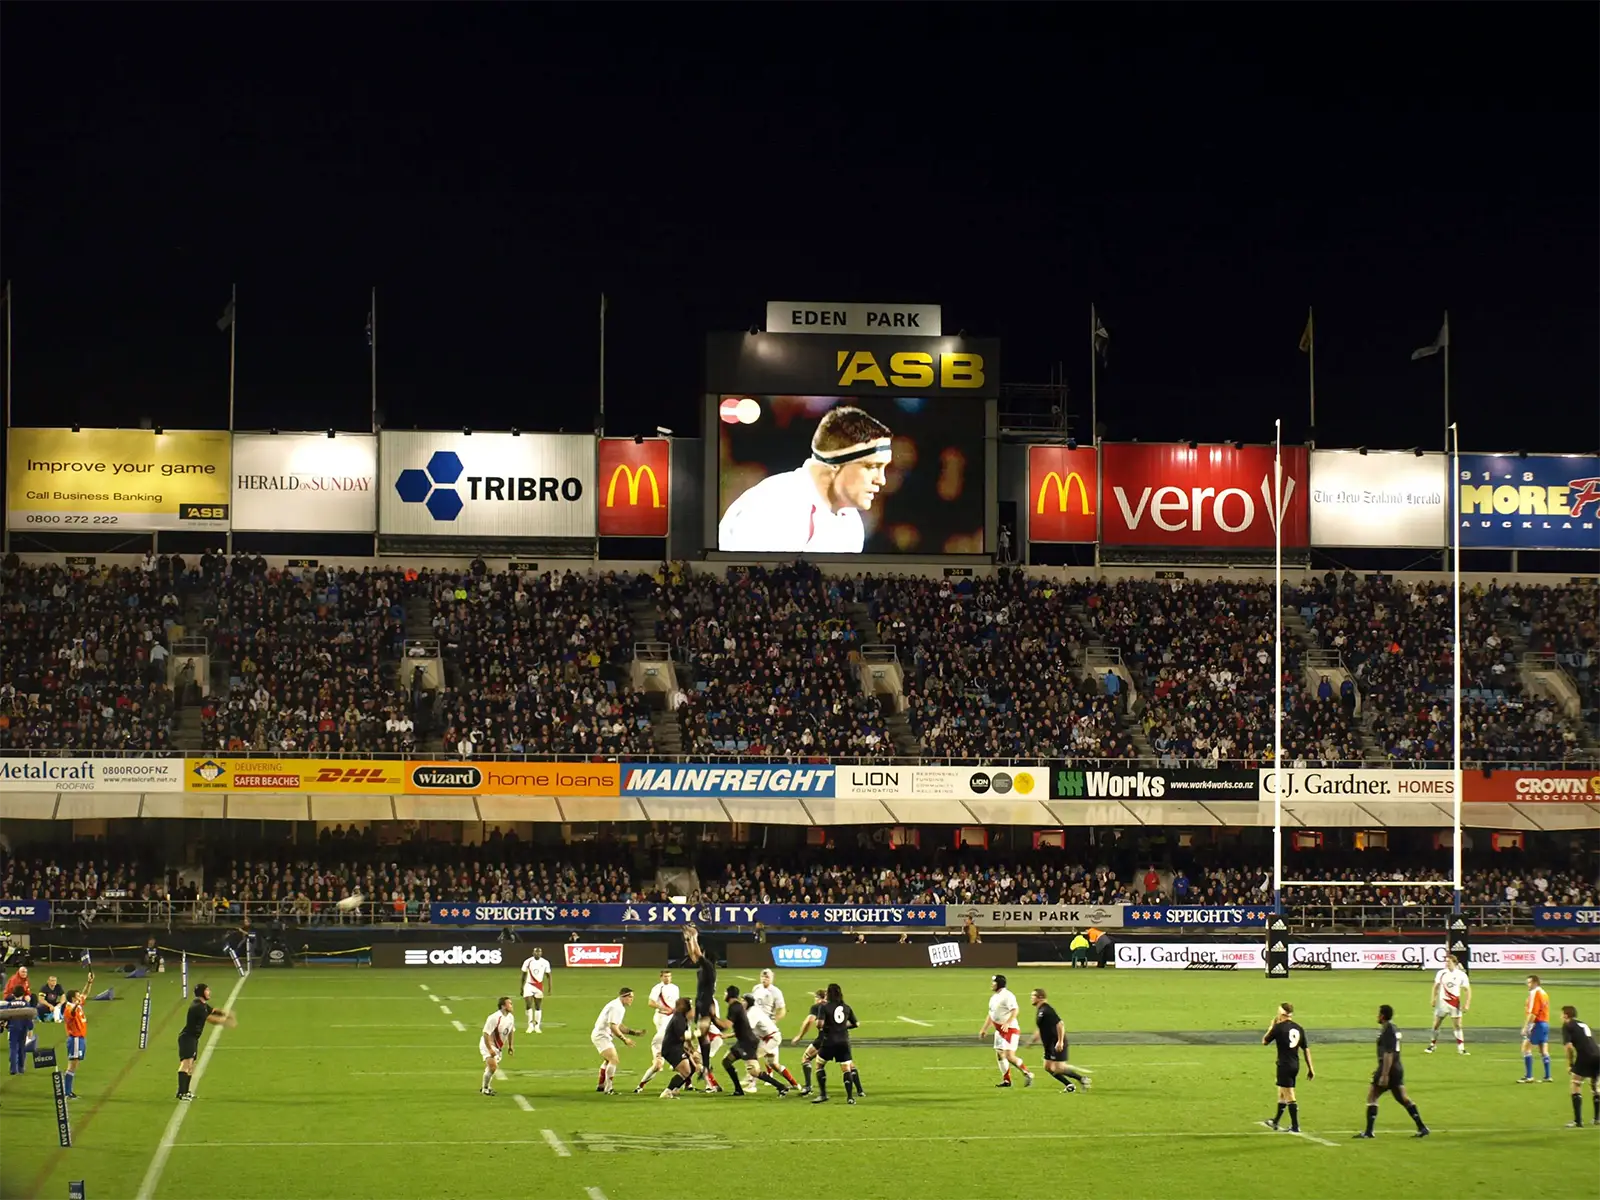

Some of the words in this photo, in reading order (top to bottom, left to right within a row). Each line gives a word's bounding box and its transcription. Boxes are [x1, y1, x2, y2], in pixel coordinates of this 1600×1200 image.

[791, 310, 847, 326] EDEN
[866, 312, 920, 328] PARK
[837, 351, 985, 388] ASB
[27, 459, 106, 474] Improve
[112, 462, 155, 475] your
[161, 463, 216, 477] game
[238, 475, 299, 490] HERALD
[311, 477, 372, 492] SUNDAY
[467, 476, 583, 502] TRIBRO
[26, 491, 49, 500] Call
[53, 492, 109, 501] Business
[113, 493, 163, 503] Banking
[1314, 490, 1333, 504] The
[1337, 491, 1360, 504] New
[1364, 490, 1402, 505] Zealand
[1407, 491, 1441, 506] Herald
[1460, 485, 1571, 515] MORE
[187, 508, 225, 519] ASB
[1113, 485, 1255, 533] vero
[26, 515, 60, 524] 0800
[64, 516, 89, 524] 272
[93, 516, 118, 524] 222
[102, 766, 169, 775] 0800ROOFNZ
[235, 763, 282, 772] DELIVERING
[316, 768, 388, 783] DHL
[234, 776, 260, 786] SAFER
[262, 777, 299, 787] BEACHES
[418, 770, 474, 785] wizard
[488, 772, 549, 786] home
[556, 773, 614, 787] loans
[626, 769, 835, 791] MAINFREIGHT
[852, 772, 899, 786] LION
[1085, 771, 1165, 797] Works
[1170, 780, 1254, 789] www.work4works.co.nz
[1304, 773, 1391, 795] Gardner.
[1398, 781, 1454, 793] HOMES
[1515, 778, 1589, 794] CROWN
[475, 906, 555, 921] SPEIGHT'S
[824, 907, 903, 923] SPEIGHT'S
[992, 911, 1032, 921] EDEN
[1039, 911, 1080, 921] PARK
[1166, 908, 1243, 923] SPEIGHT'S
[429, 946, 502, 964] adidas
[778, 949, 822, 959] IVECO
[931, 945, 957, 960] REBEL
[1118, 946, 1146, 965] G.J.
[1150, 946, 1218, 963] Gardner.
[1222, 953, 1255, 961] HOMES
[1292, 947, 1360, 963] Gardner.
[1363, 953, 1396, 961] HOMES
[1402, 947, 1430, 965] G.J.
[1503, 953, 1536, 961] HOMES
[1541, 947, 1570, 966] G.J.
[834, 1005, 845, 1023] 6
[1288, 1028, 1300, 1048] 9
[60, 1123, 68, 1145] IVECO
